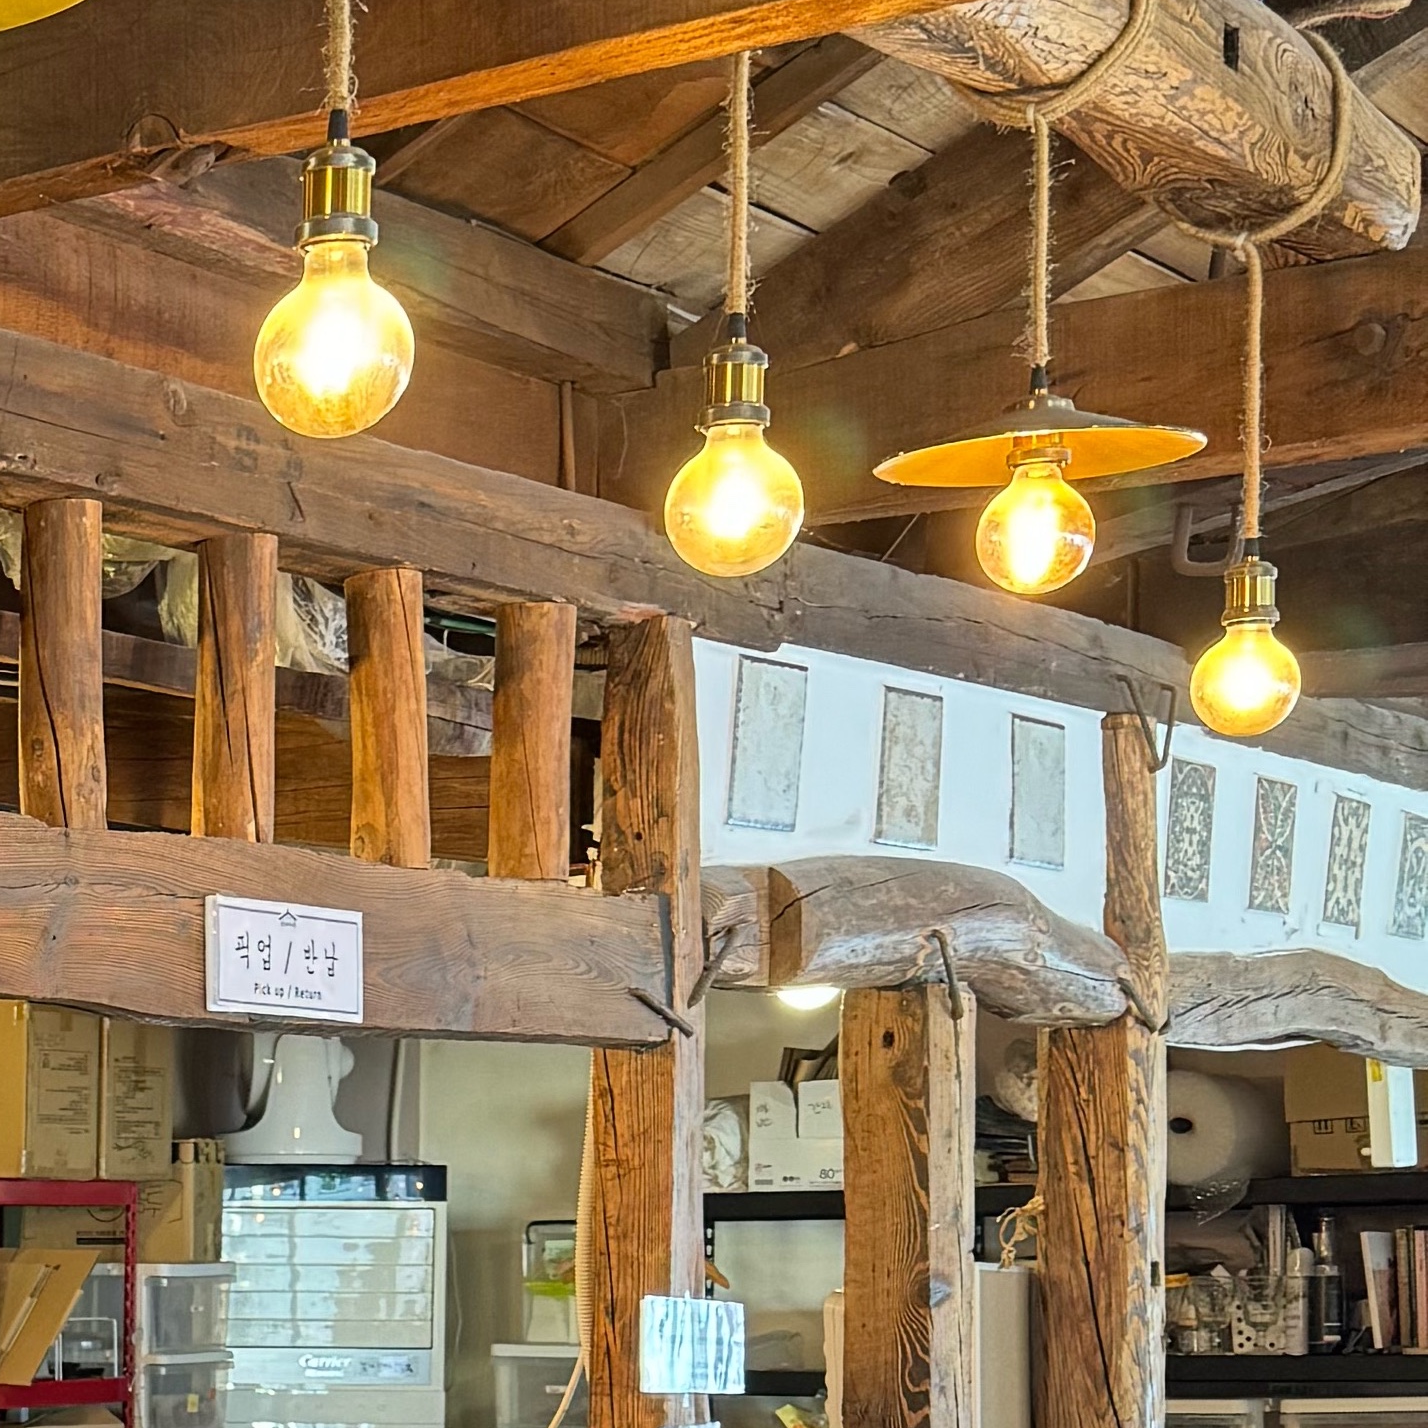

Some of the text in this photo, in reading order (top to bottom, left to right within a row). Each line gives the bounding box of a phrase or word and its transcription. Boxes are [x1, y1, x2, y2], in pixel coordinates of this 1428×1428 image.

[235, 931, 271, 971] 픽업
[304, 939, 338, 977] 반납
[254, 983, 271, 995] Pick
[275, 987, 284, 998] up
[295, 986, 322, 1000] Return
[819, 1168, 835, 1180] 80
[298, 1352, 352, 1369] Carrier
